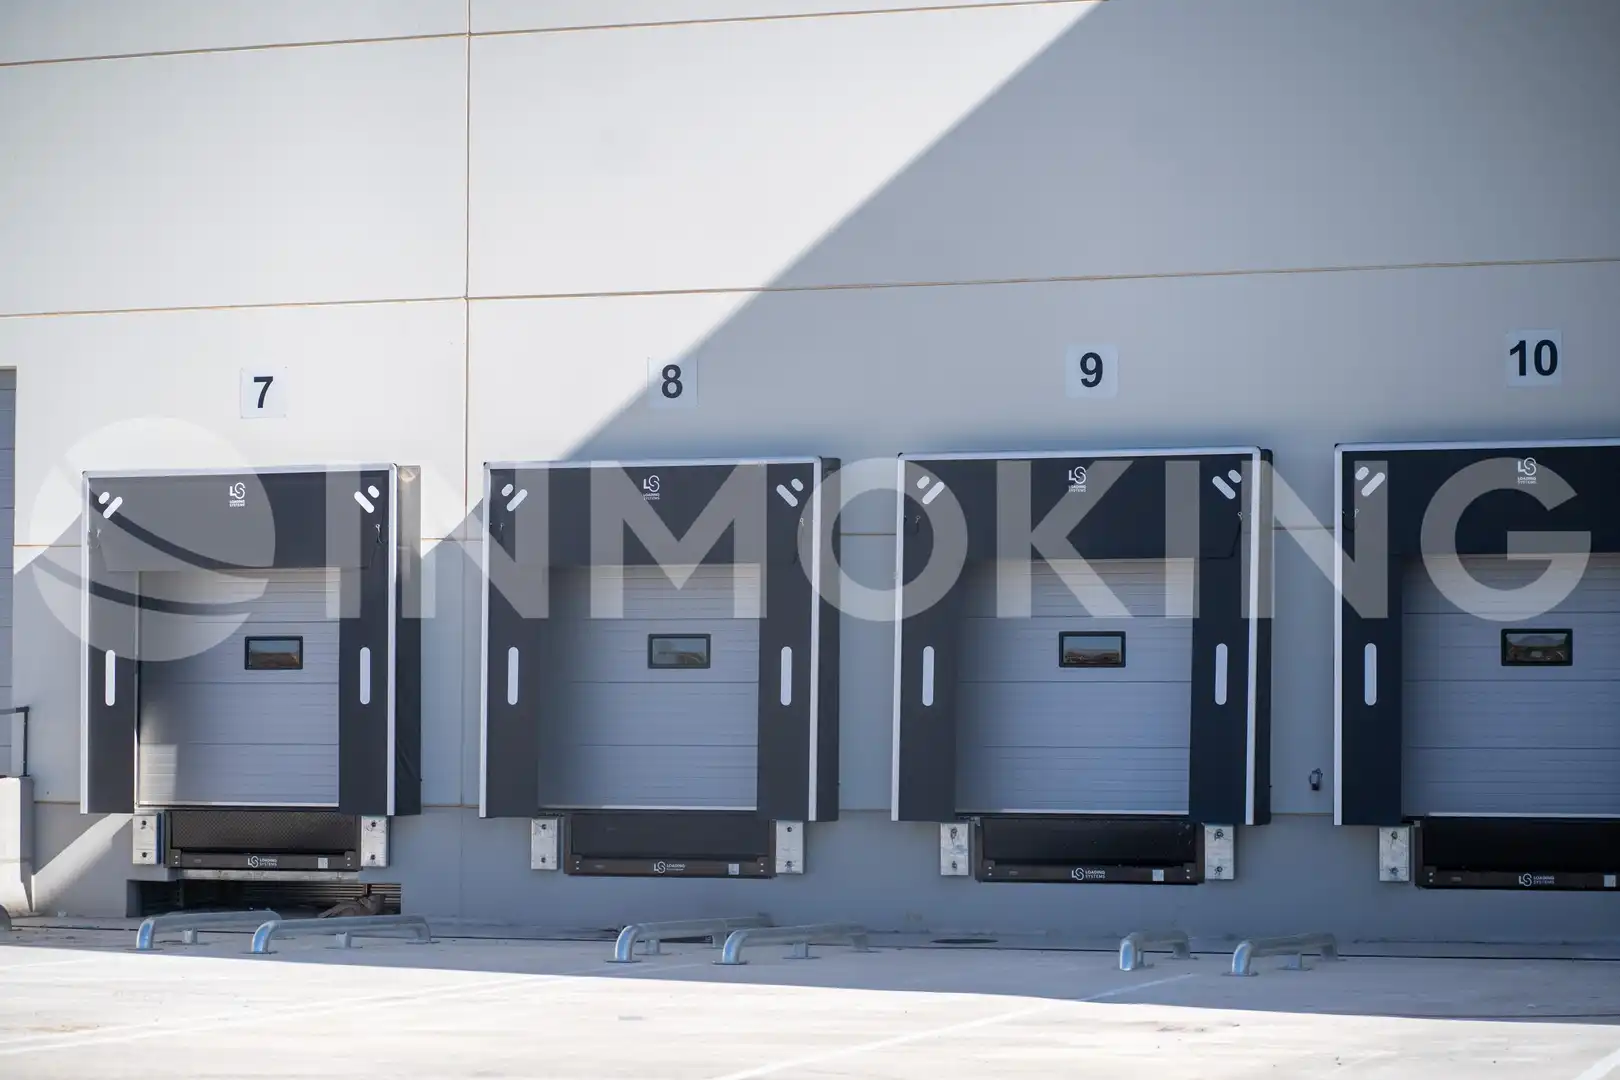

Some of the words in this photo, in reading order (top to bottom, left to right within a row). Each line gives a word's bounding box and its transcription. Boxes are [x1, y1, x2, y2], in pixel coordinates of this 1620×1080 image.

[1080, 352, 1103, 387] 9
[1509, 340, 1558, 376] 10
[253, 377, 274, 408] 7
[661, 364, 683, 399] 8
